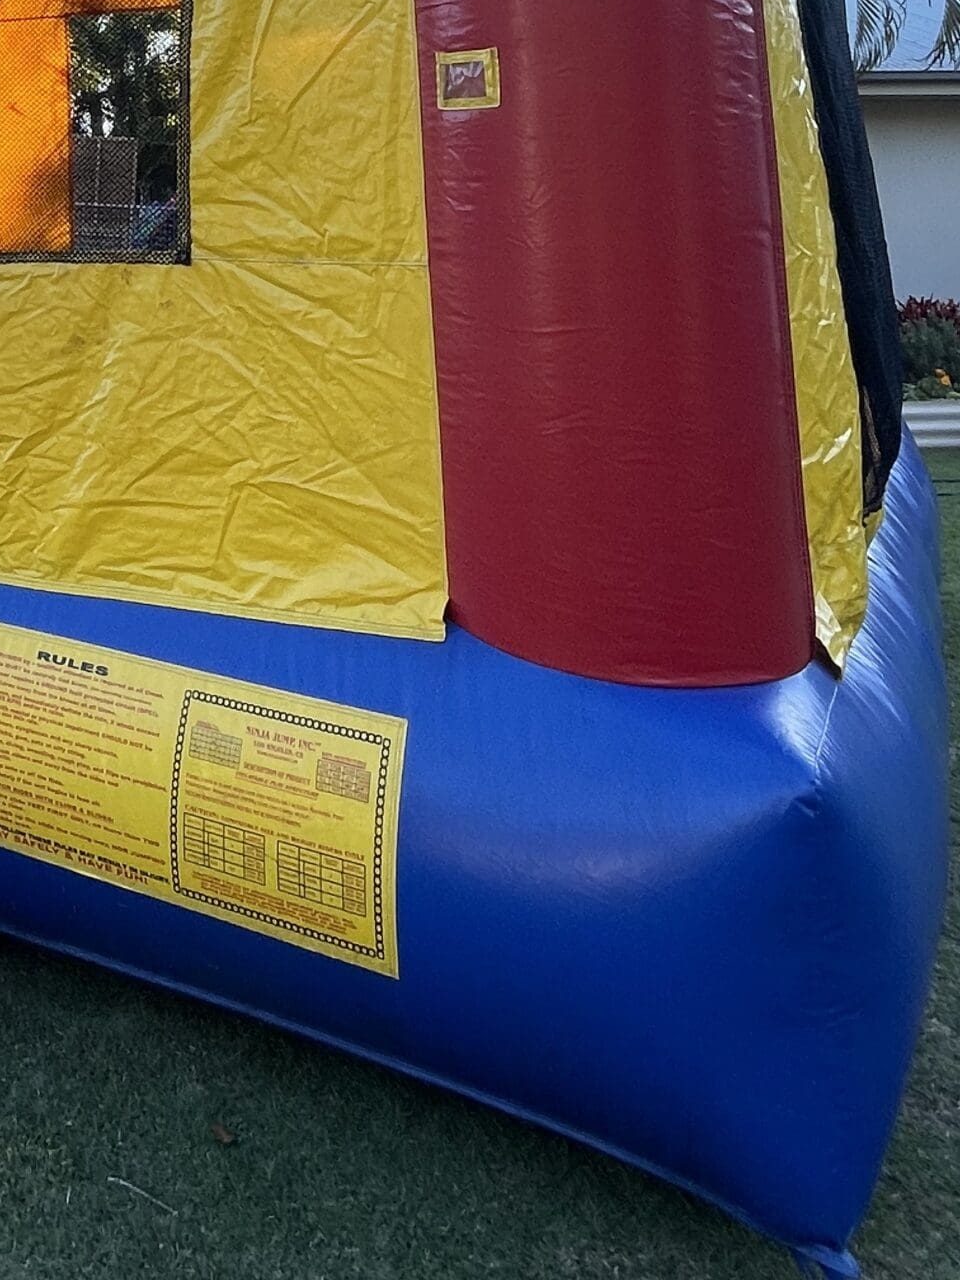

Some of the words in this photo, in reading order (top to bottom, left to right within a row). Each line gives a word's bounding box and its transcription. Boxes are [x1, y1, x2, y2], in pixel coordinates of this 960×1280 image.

[37, 650, 109, 676] RULES
[246, 726, 271, 740] NINJA
[14, 835, 58, 855] SAFELY
[77, 856, 112, 873] HAVE
